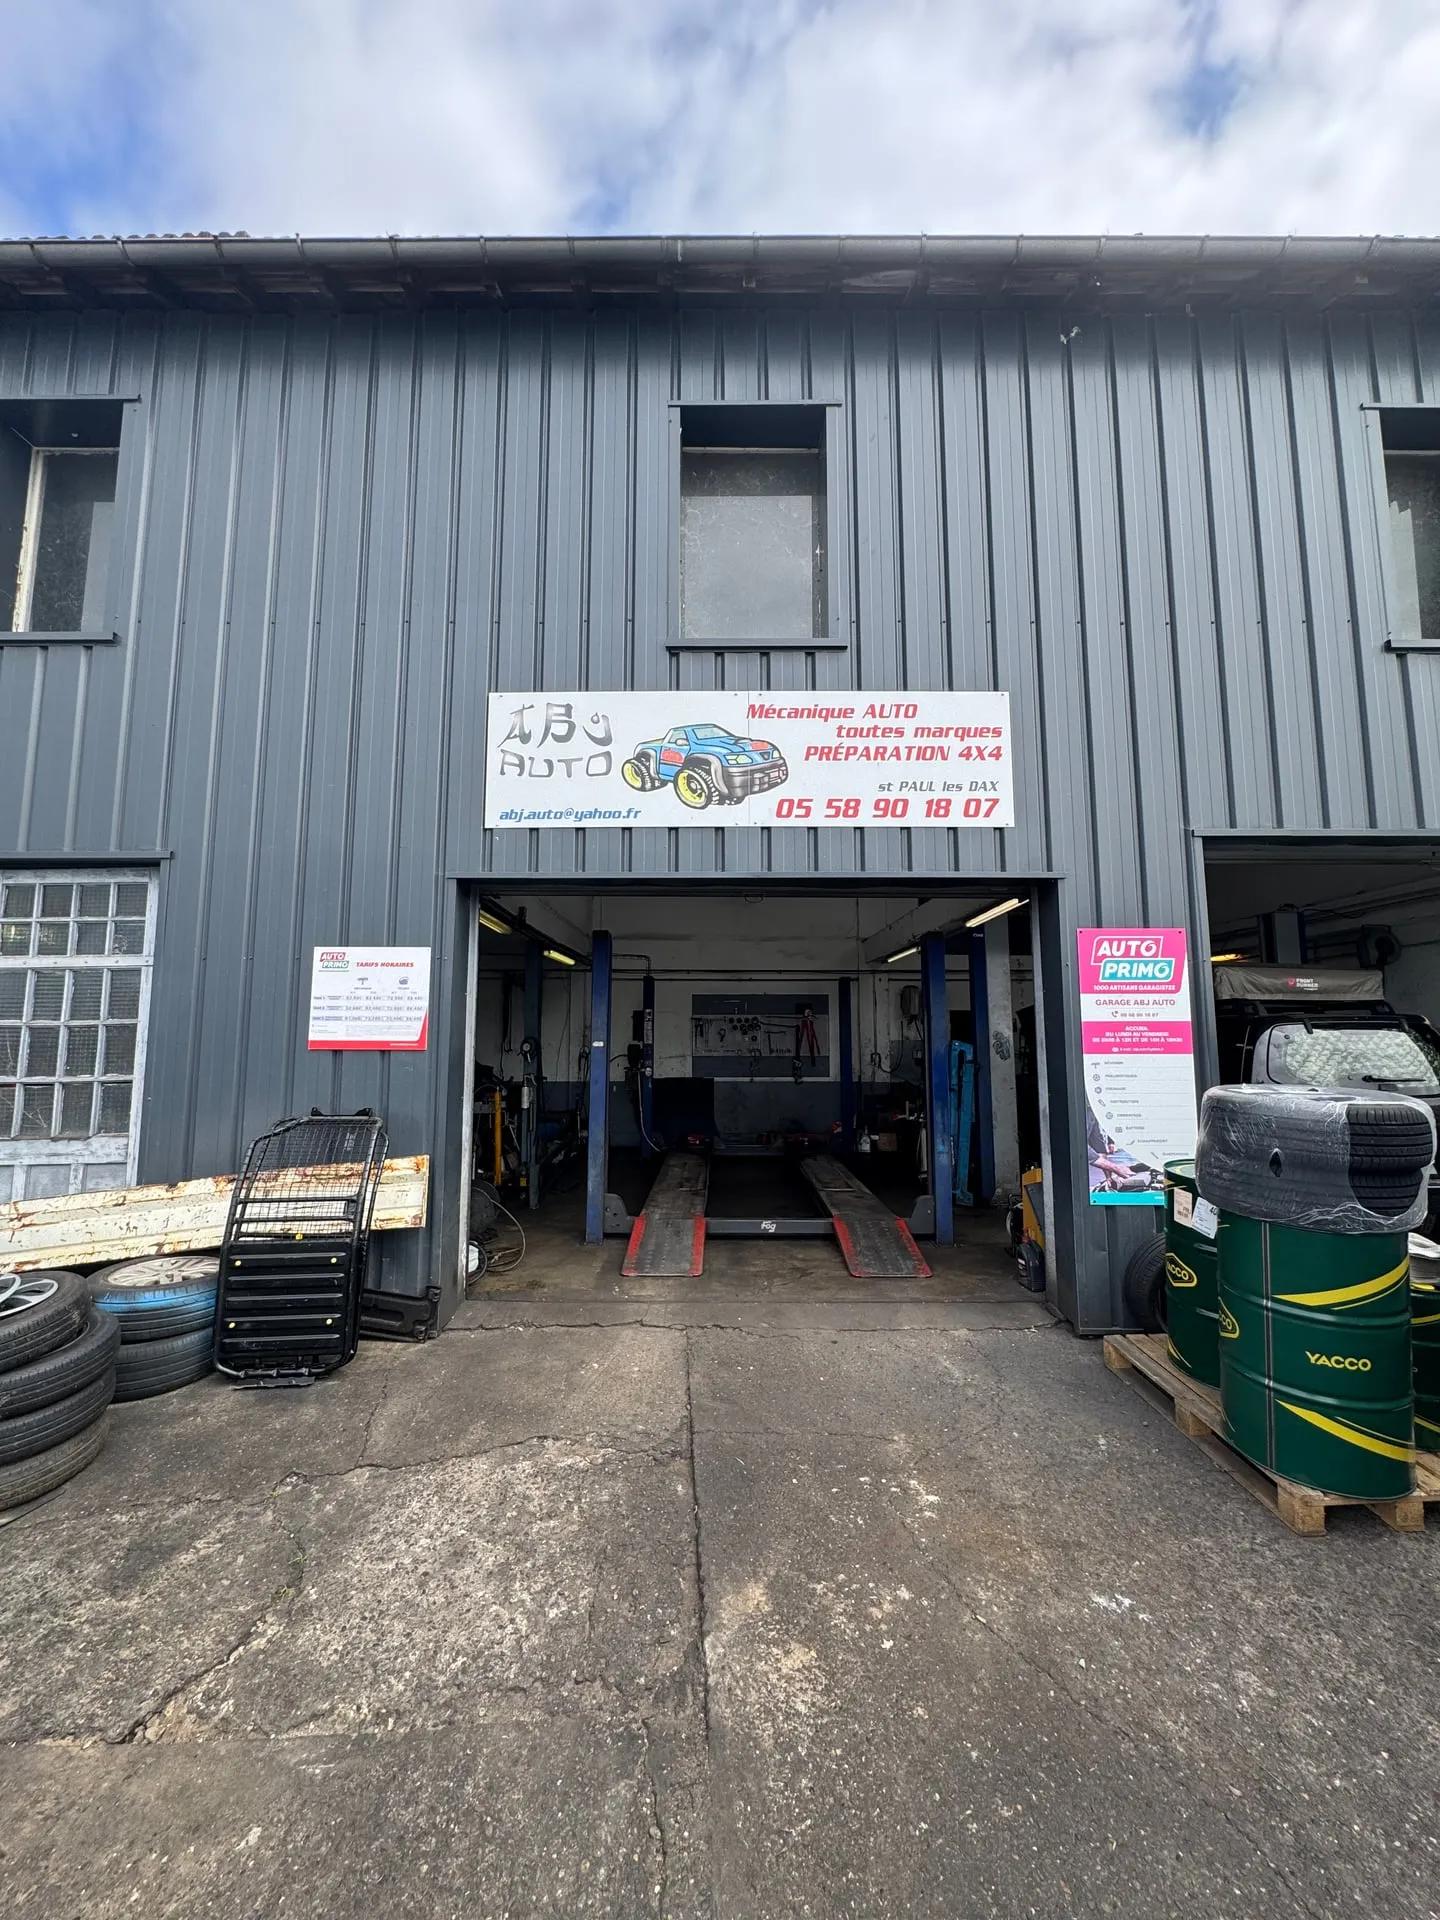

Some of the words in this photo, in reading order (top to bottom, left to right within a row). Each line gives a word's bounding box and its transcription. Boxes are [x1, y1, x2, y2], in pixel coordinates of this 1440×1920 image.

[747, 703, 855, 722] Mécanique
[862, 703, 918, 719] AUTO
[836, 724, 905, 738] toutes
[914, 725, 1002, 742] marques
[804, 743, 950, 762] PRÉPARATION
[958, 745, 1003, 762] 4X4
[500, 749, 613, 778] AUTO
[878, 782, 894, 792] st
[899, 781, 936, 792] PAUL
[942, 781, 963, 792] les
[968, 781, 999, 792] DAX
[499, 807, 641, 823] abj.auto@yahoo.fr
[776, 798, 812, 818] 05
[824, 798, 861, 818] 58
[872, 798, 909, 818] 90
[925, 798, 951, 818] 18
[963, 798, 999, 818] 07
[1097, 940, 1157, 957] AUTO
[1104, 962, 1170, 978] PRIMO
[1305, 1351, 1372, 1371] YACCO
